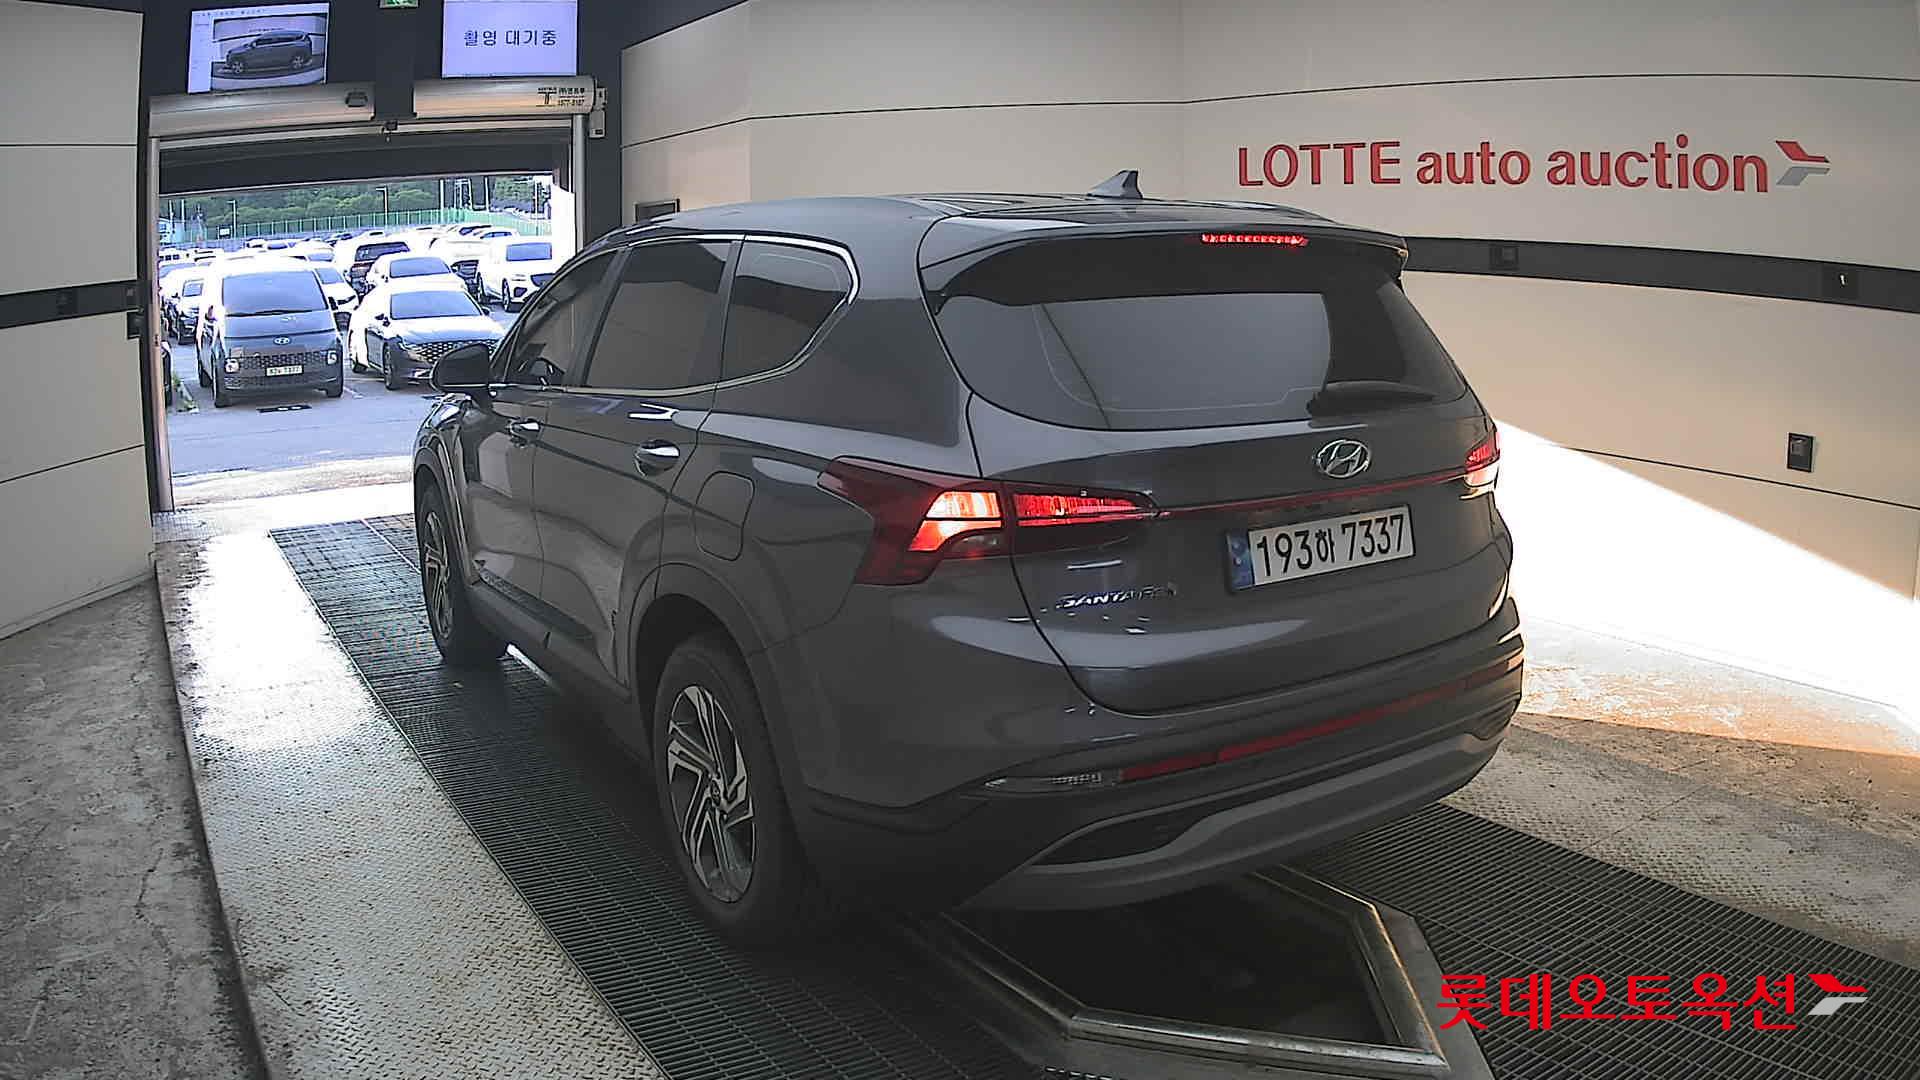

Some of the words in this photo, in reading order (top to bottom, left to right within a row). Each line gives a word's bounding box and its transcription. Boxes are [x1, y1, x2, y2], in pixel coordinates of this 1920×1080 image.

[464, 30, 497, 47] 촬영
[505, 30, 557, 46] 대기중
[1239, 141, 1400, 187] LOTTE
[1417, 142, 1530, 186] auto
[1546, 135, 1769, 193] auction
[1257, 528, 1335, 577] 193하
[1341, 514, 1404, 561] 7337
